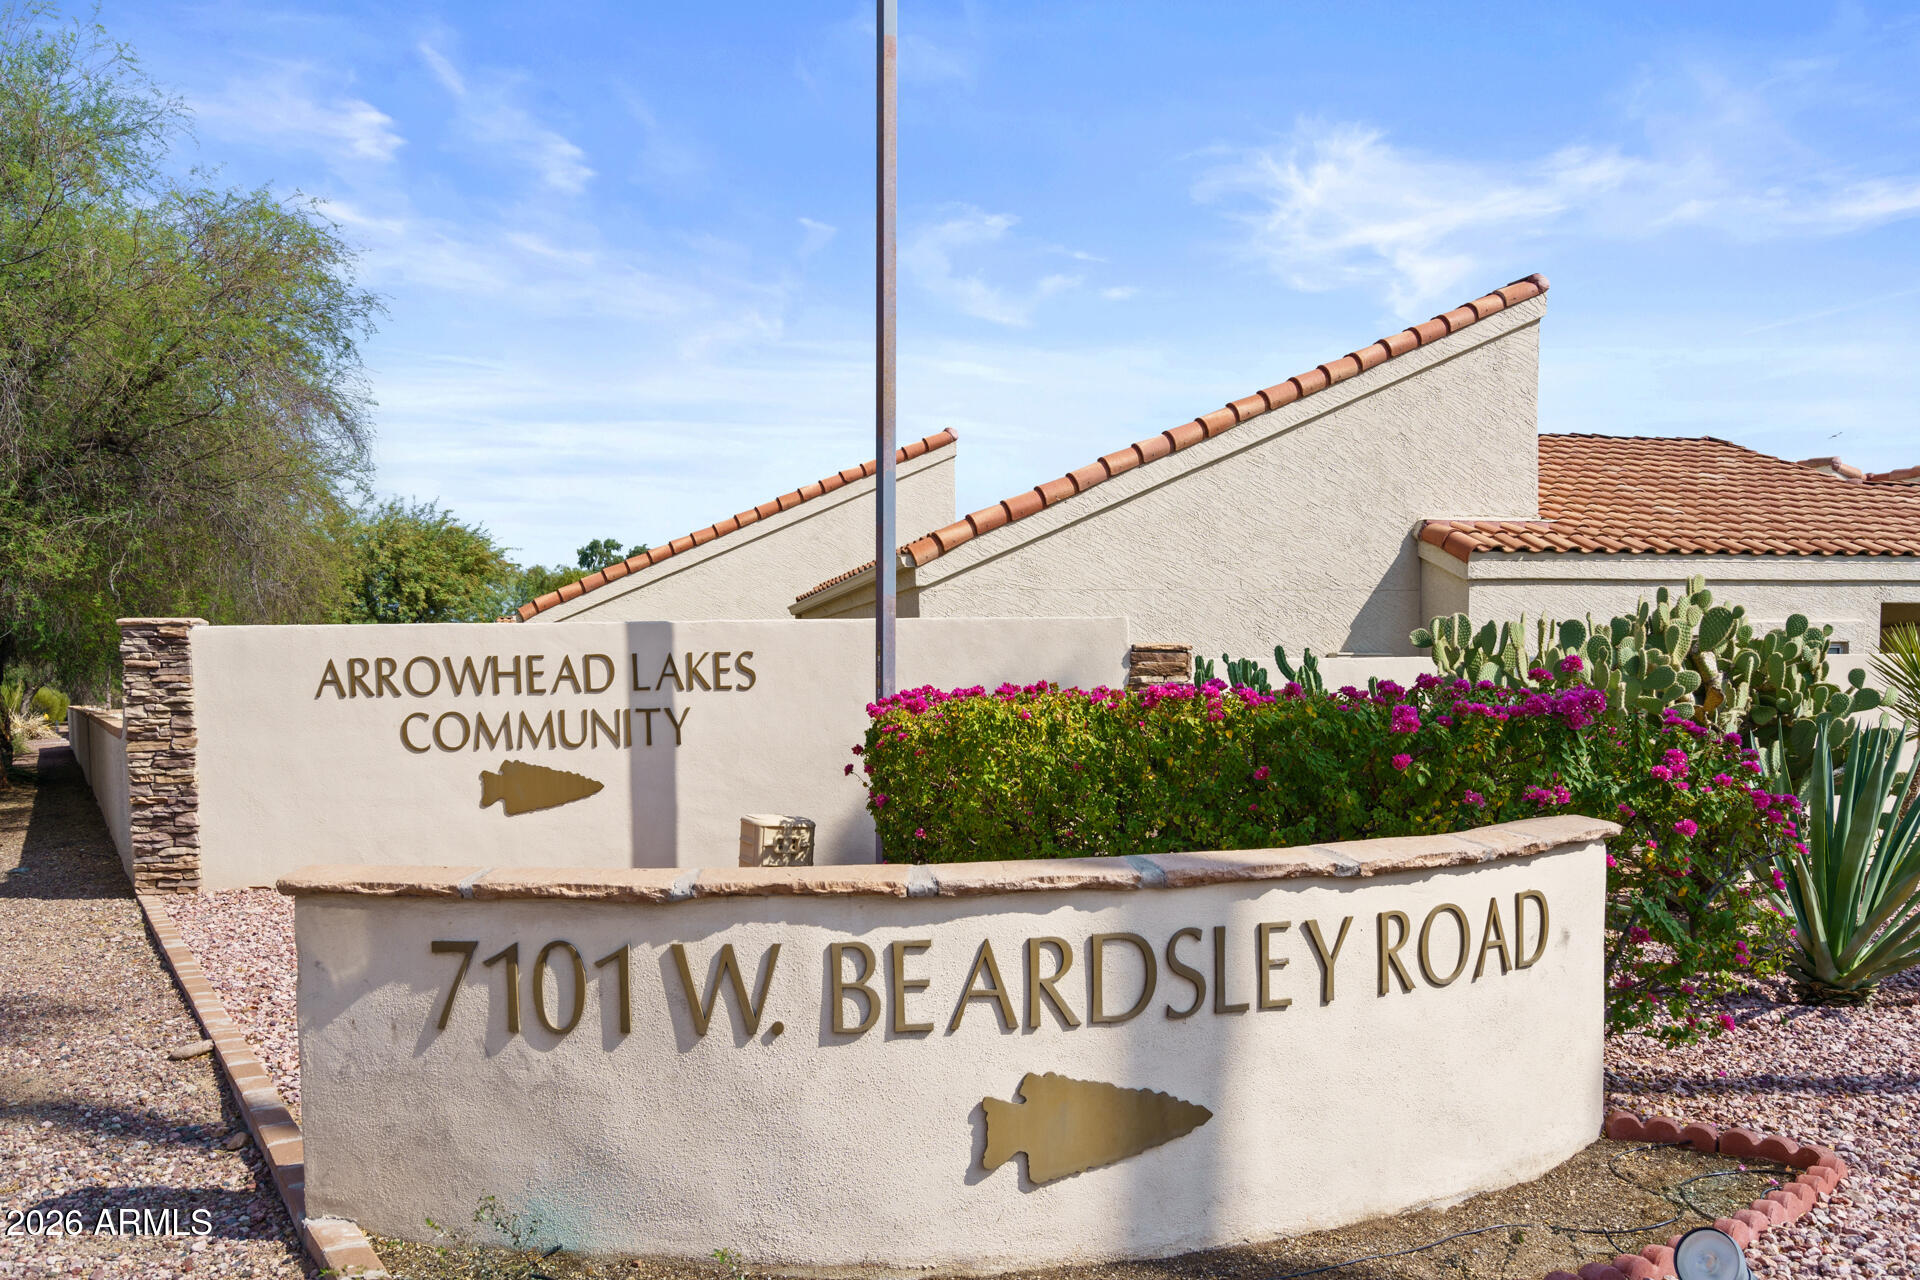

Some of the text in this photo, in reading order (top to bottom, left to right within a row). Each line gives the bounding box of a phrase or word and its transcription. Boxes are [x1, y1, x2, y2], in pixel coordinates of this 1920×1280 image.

[316, 651, 757, 698] ARROWHEAD LAKES
[400, 707, 690, 752] COMMUNITY
[431, 889, 1549, 1036] 7101 W. BEARDSLEY ROAD
